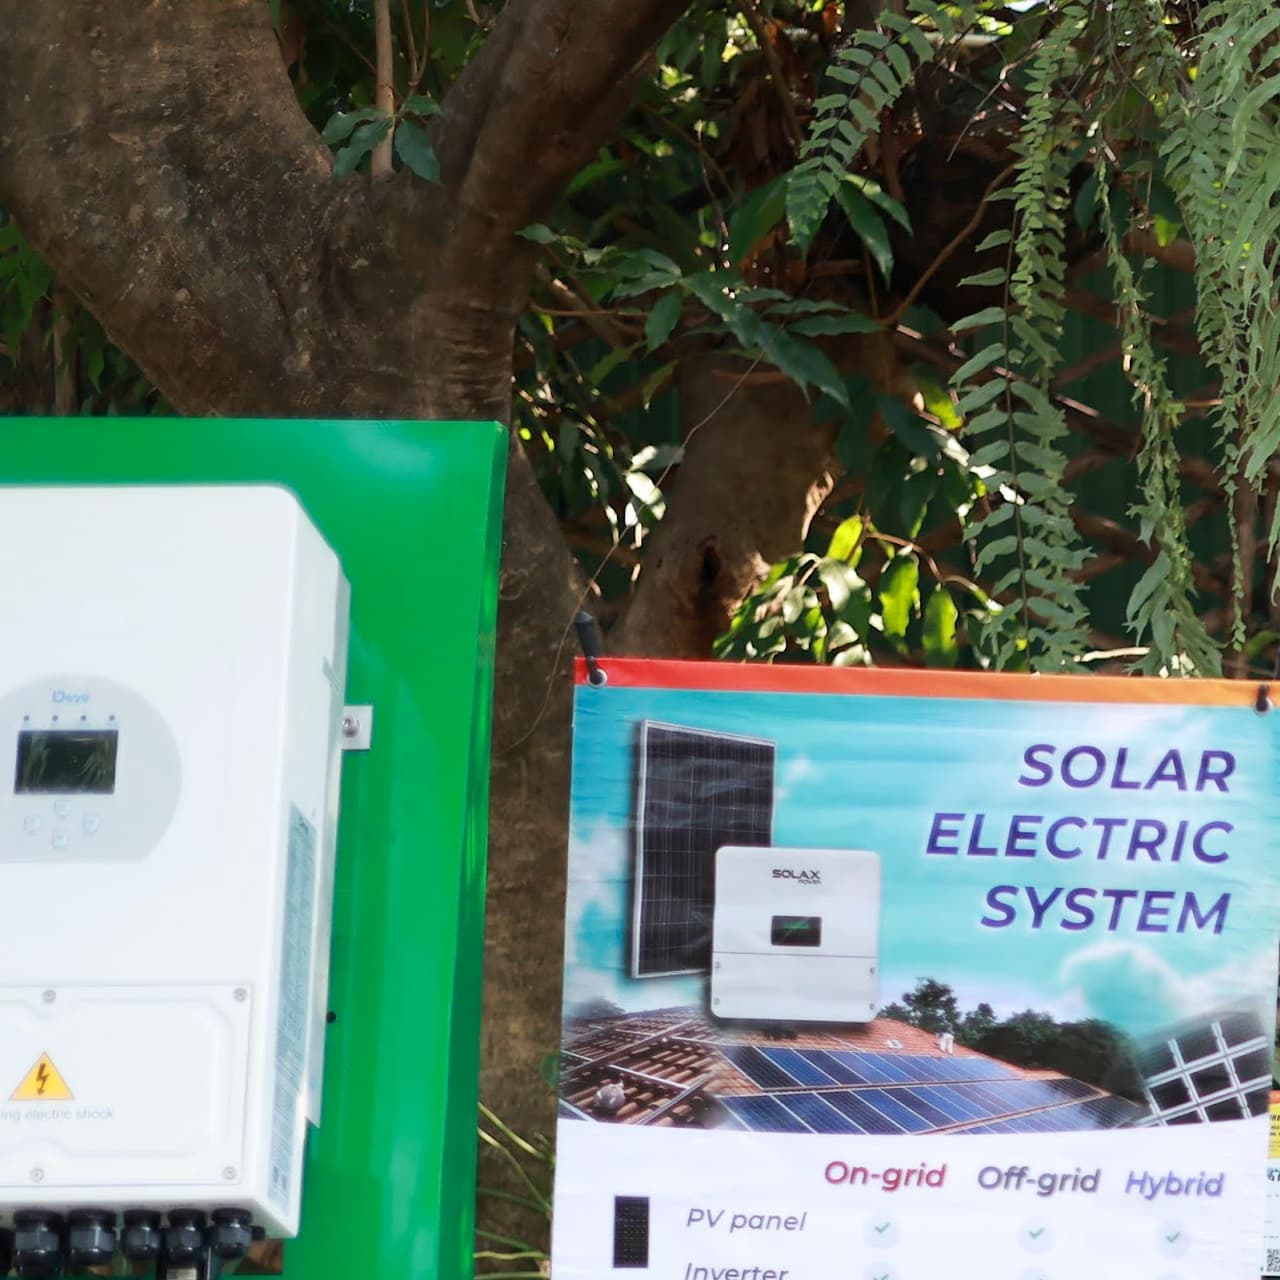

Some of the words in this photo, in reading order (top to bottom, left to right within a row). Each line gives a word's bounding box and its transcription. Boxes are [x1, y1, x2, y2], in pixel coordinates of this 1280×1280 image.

[1018, 743, 1236, 793] SOLAR
[925, 812, 1235, 864] ELECTRIC
[772, 869, 821, 880] SOLAX
[980, 884, 1232, 935] SYSTEM
[823, 1160, 947, 1193] On-grid
[977, 1165, 1102, 1198] Off-grid
[1124, 1170, 1226, 1202] Hybrid
[685, 1207, 726, 1229] PV
[729, 1211, 808, 1234] panel
